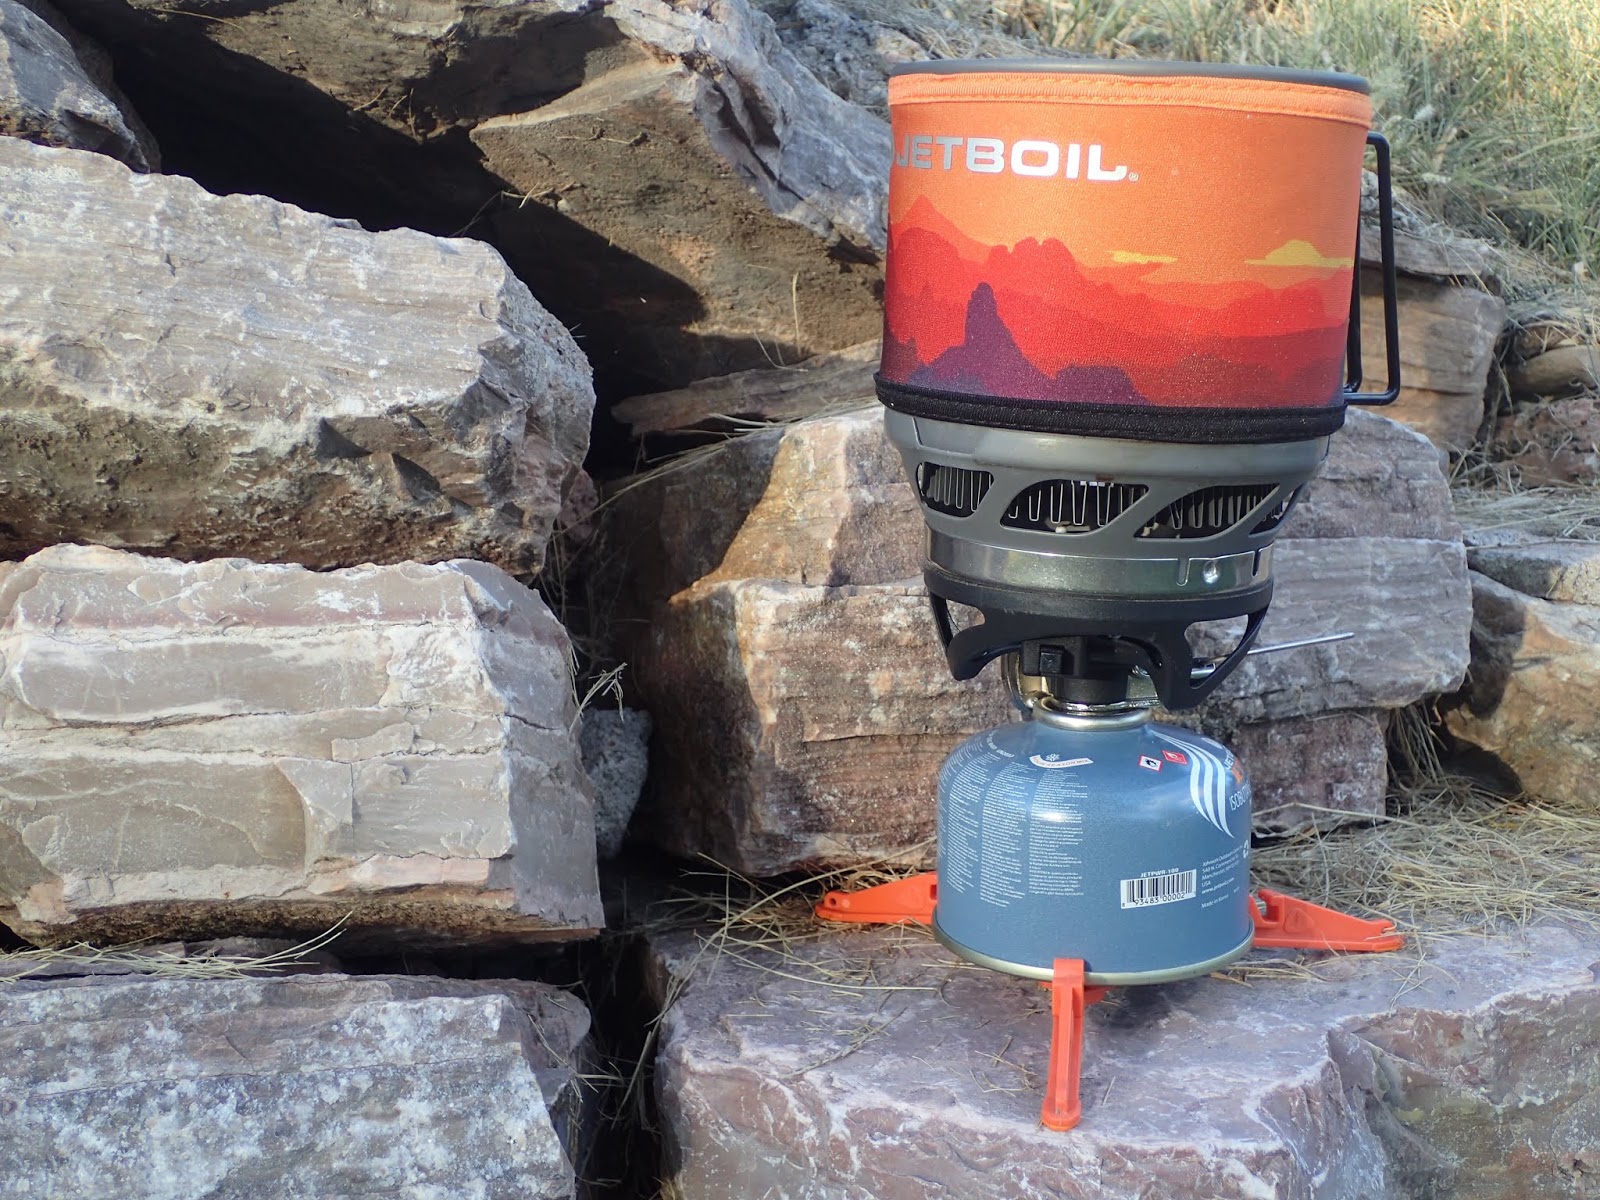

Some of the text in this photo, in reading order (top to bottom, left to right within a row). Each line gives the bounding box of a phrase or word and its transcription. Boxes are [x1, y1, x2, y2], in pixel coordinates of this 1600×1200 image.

[896, 134, 1128, 181] JETBOIL
[1140, 867, 1179, 878] JETPWR-100
[1201, 880, 1211, 888] USA
[1134, 897, 1159, 906] 93483
[1162, 892, 1186, 902] 00002
